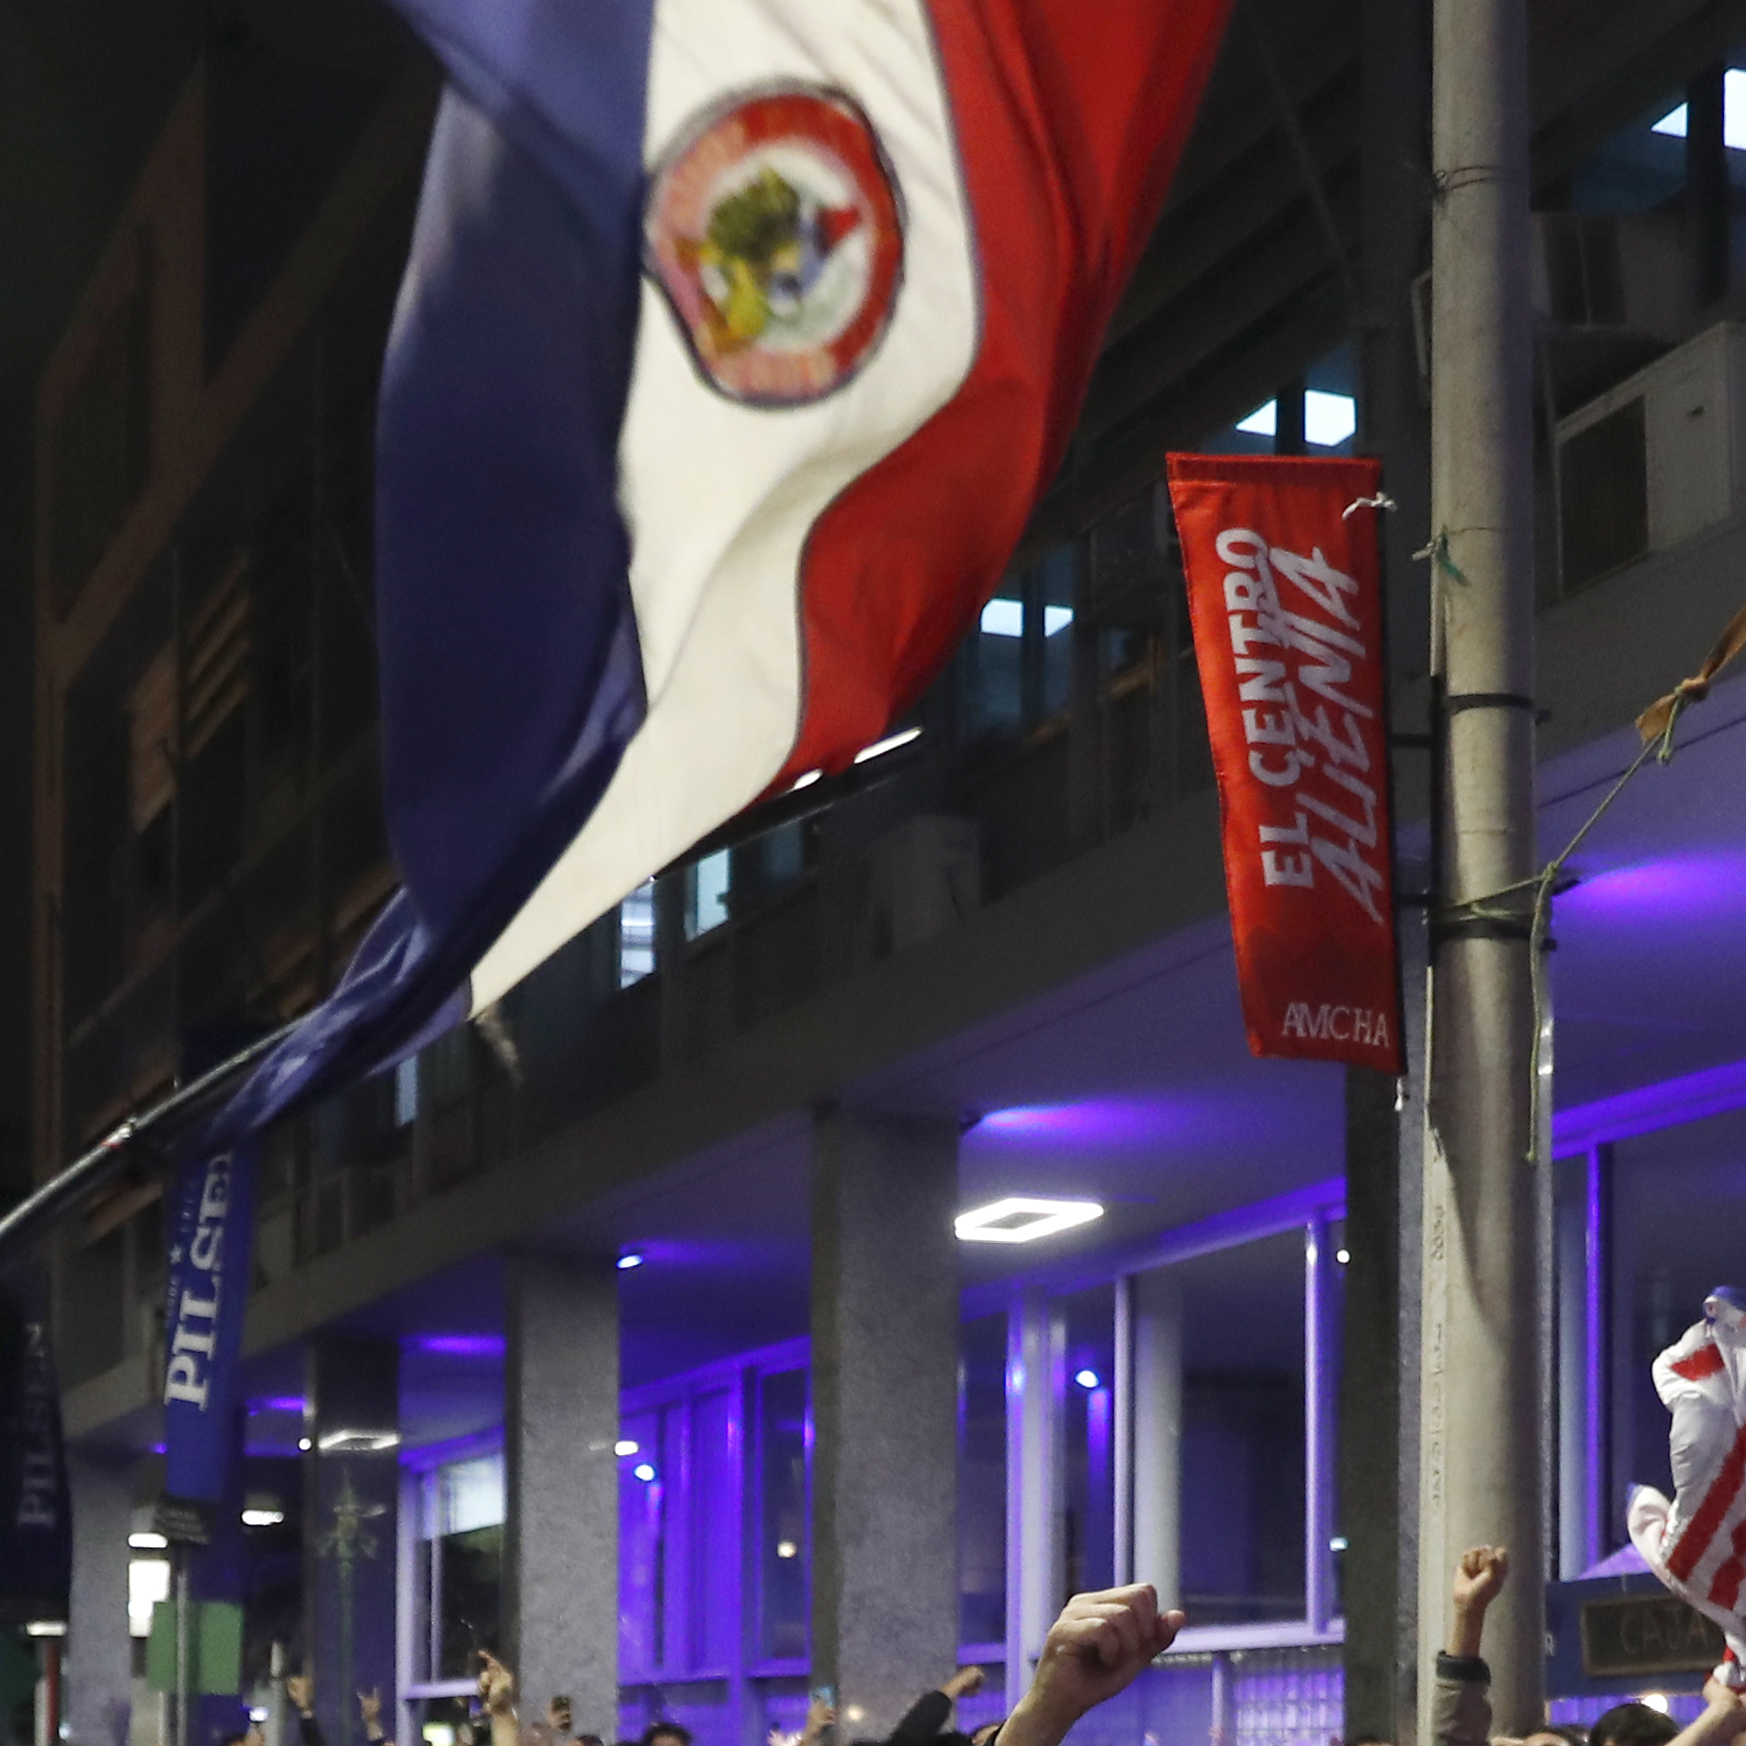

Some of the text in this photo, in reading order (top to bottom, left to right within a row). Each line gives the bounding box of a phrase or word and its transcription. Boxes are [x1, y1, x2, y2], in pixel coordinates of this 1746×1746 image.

[1215, 527, 1315, 889] EL CENTRO
[1281, 1001, 1390, 1049] AMCHA
